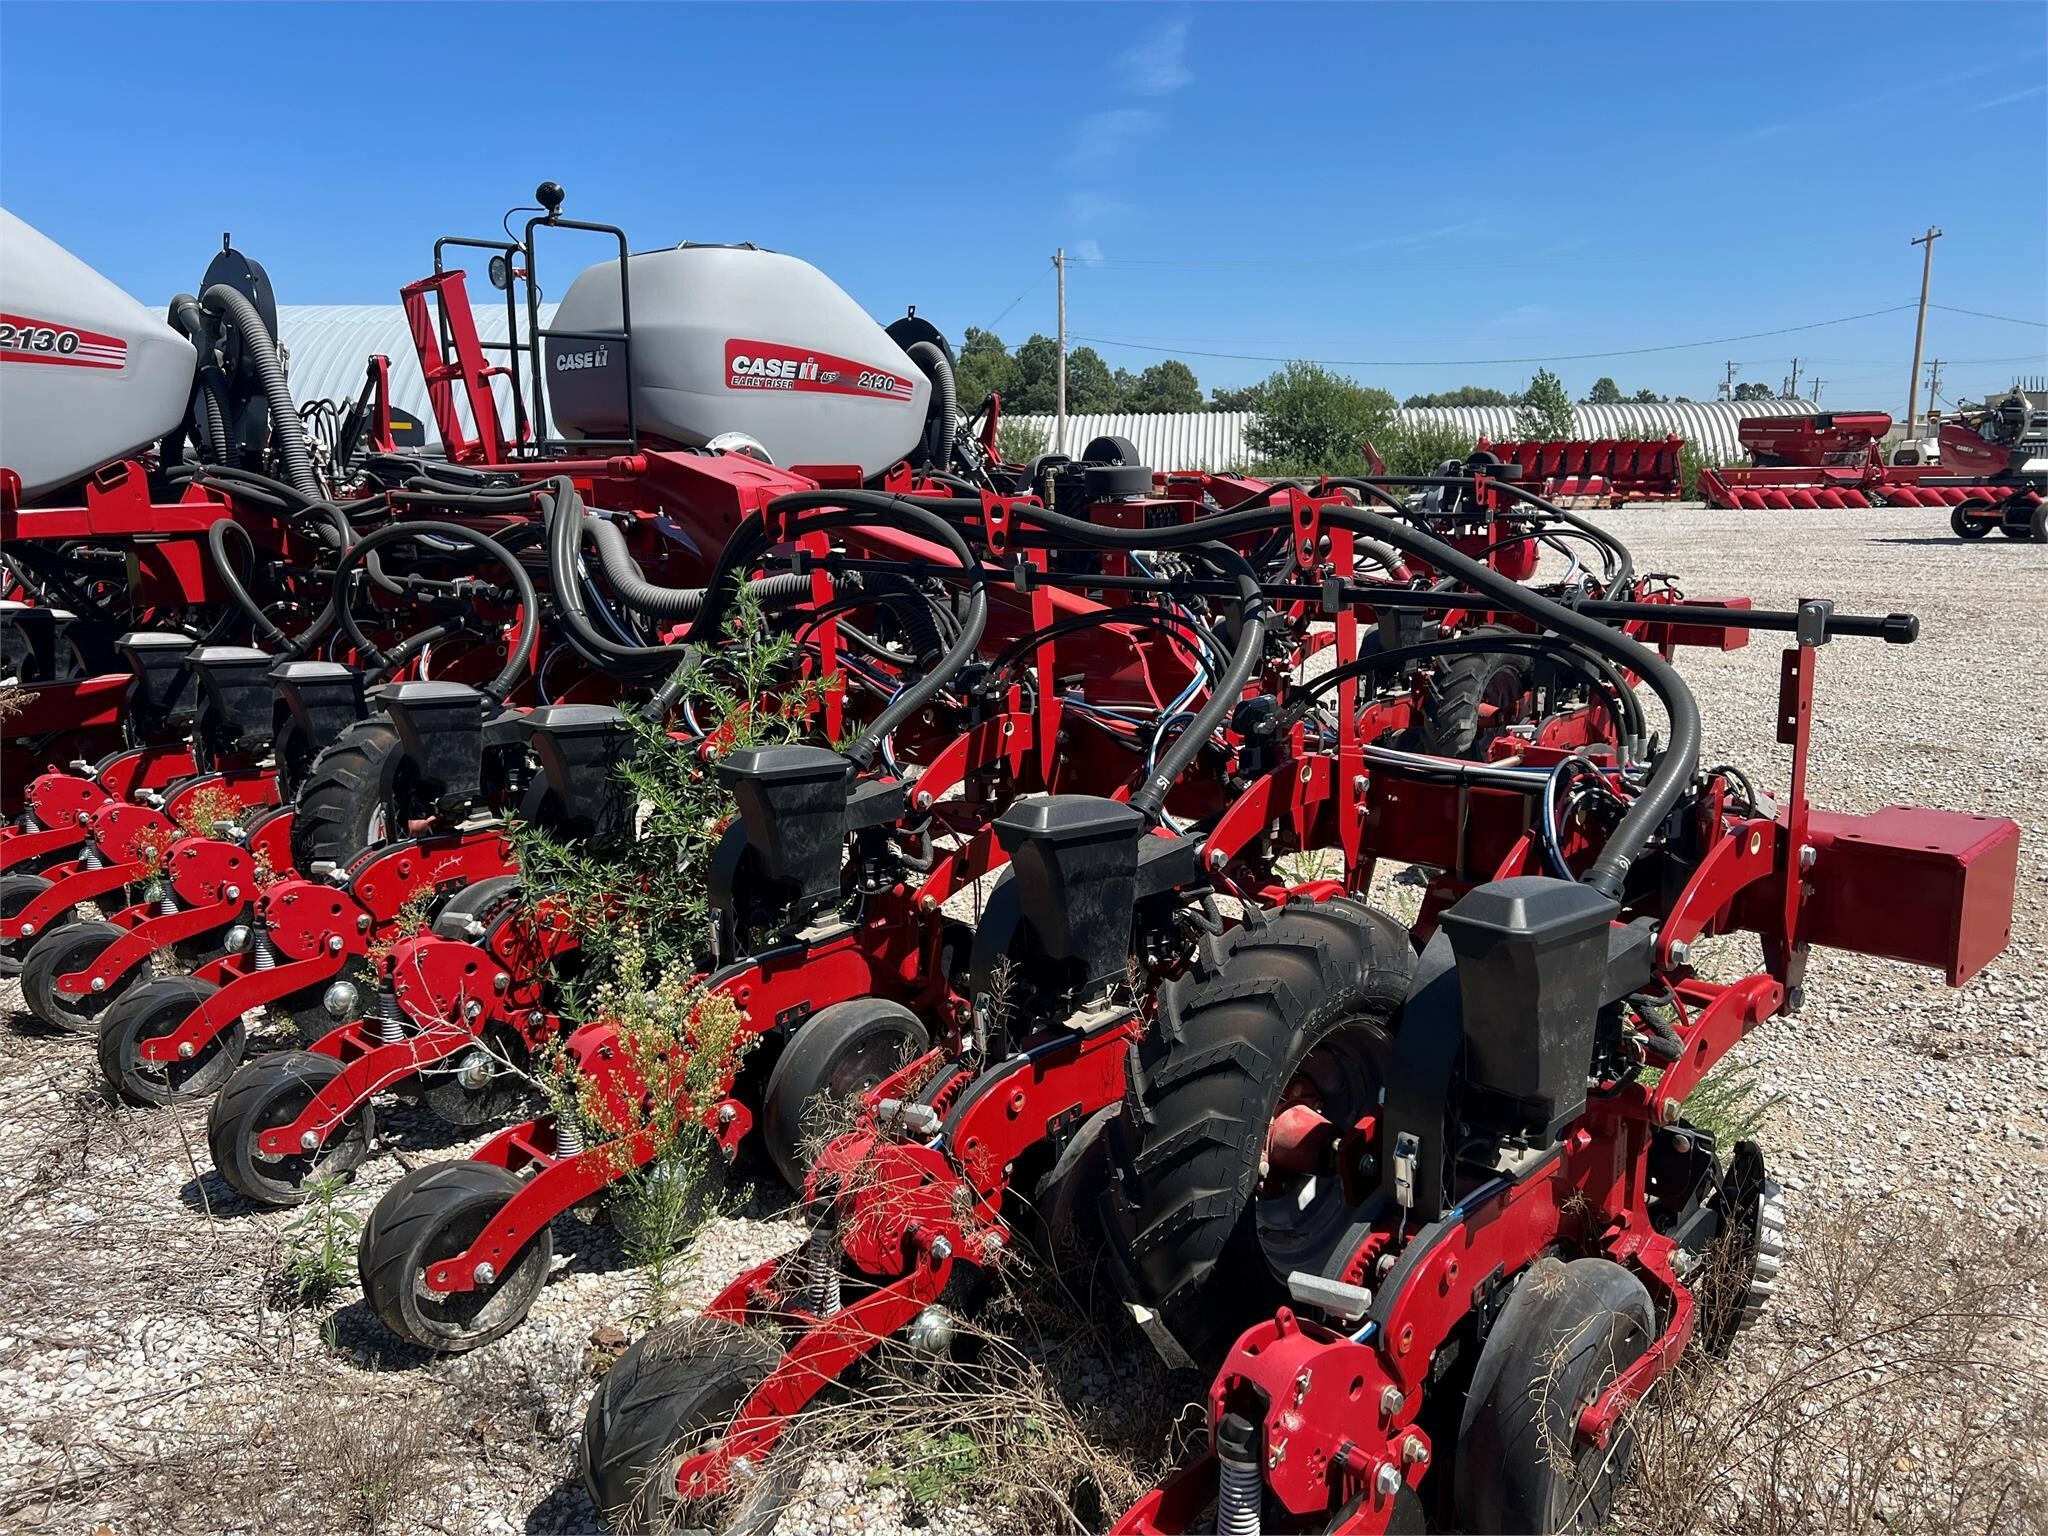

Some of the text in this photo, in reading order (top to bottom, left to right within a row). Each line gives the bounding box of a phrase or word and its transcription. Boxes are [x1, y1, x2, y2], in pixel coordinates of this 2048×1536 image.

[0, 323, 80, 354] 2130
[556, 351, 593, 371] CASE
[731, 355, 797, 379] CASE
[731, 376, 795, 389] EARLY RISER
[858, 371, 895, 391] 2130
[1156, 774, 1171, 791] 15
